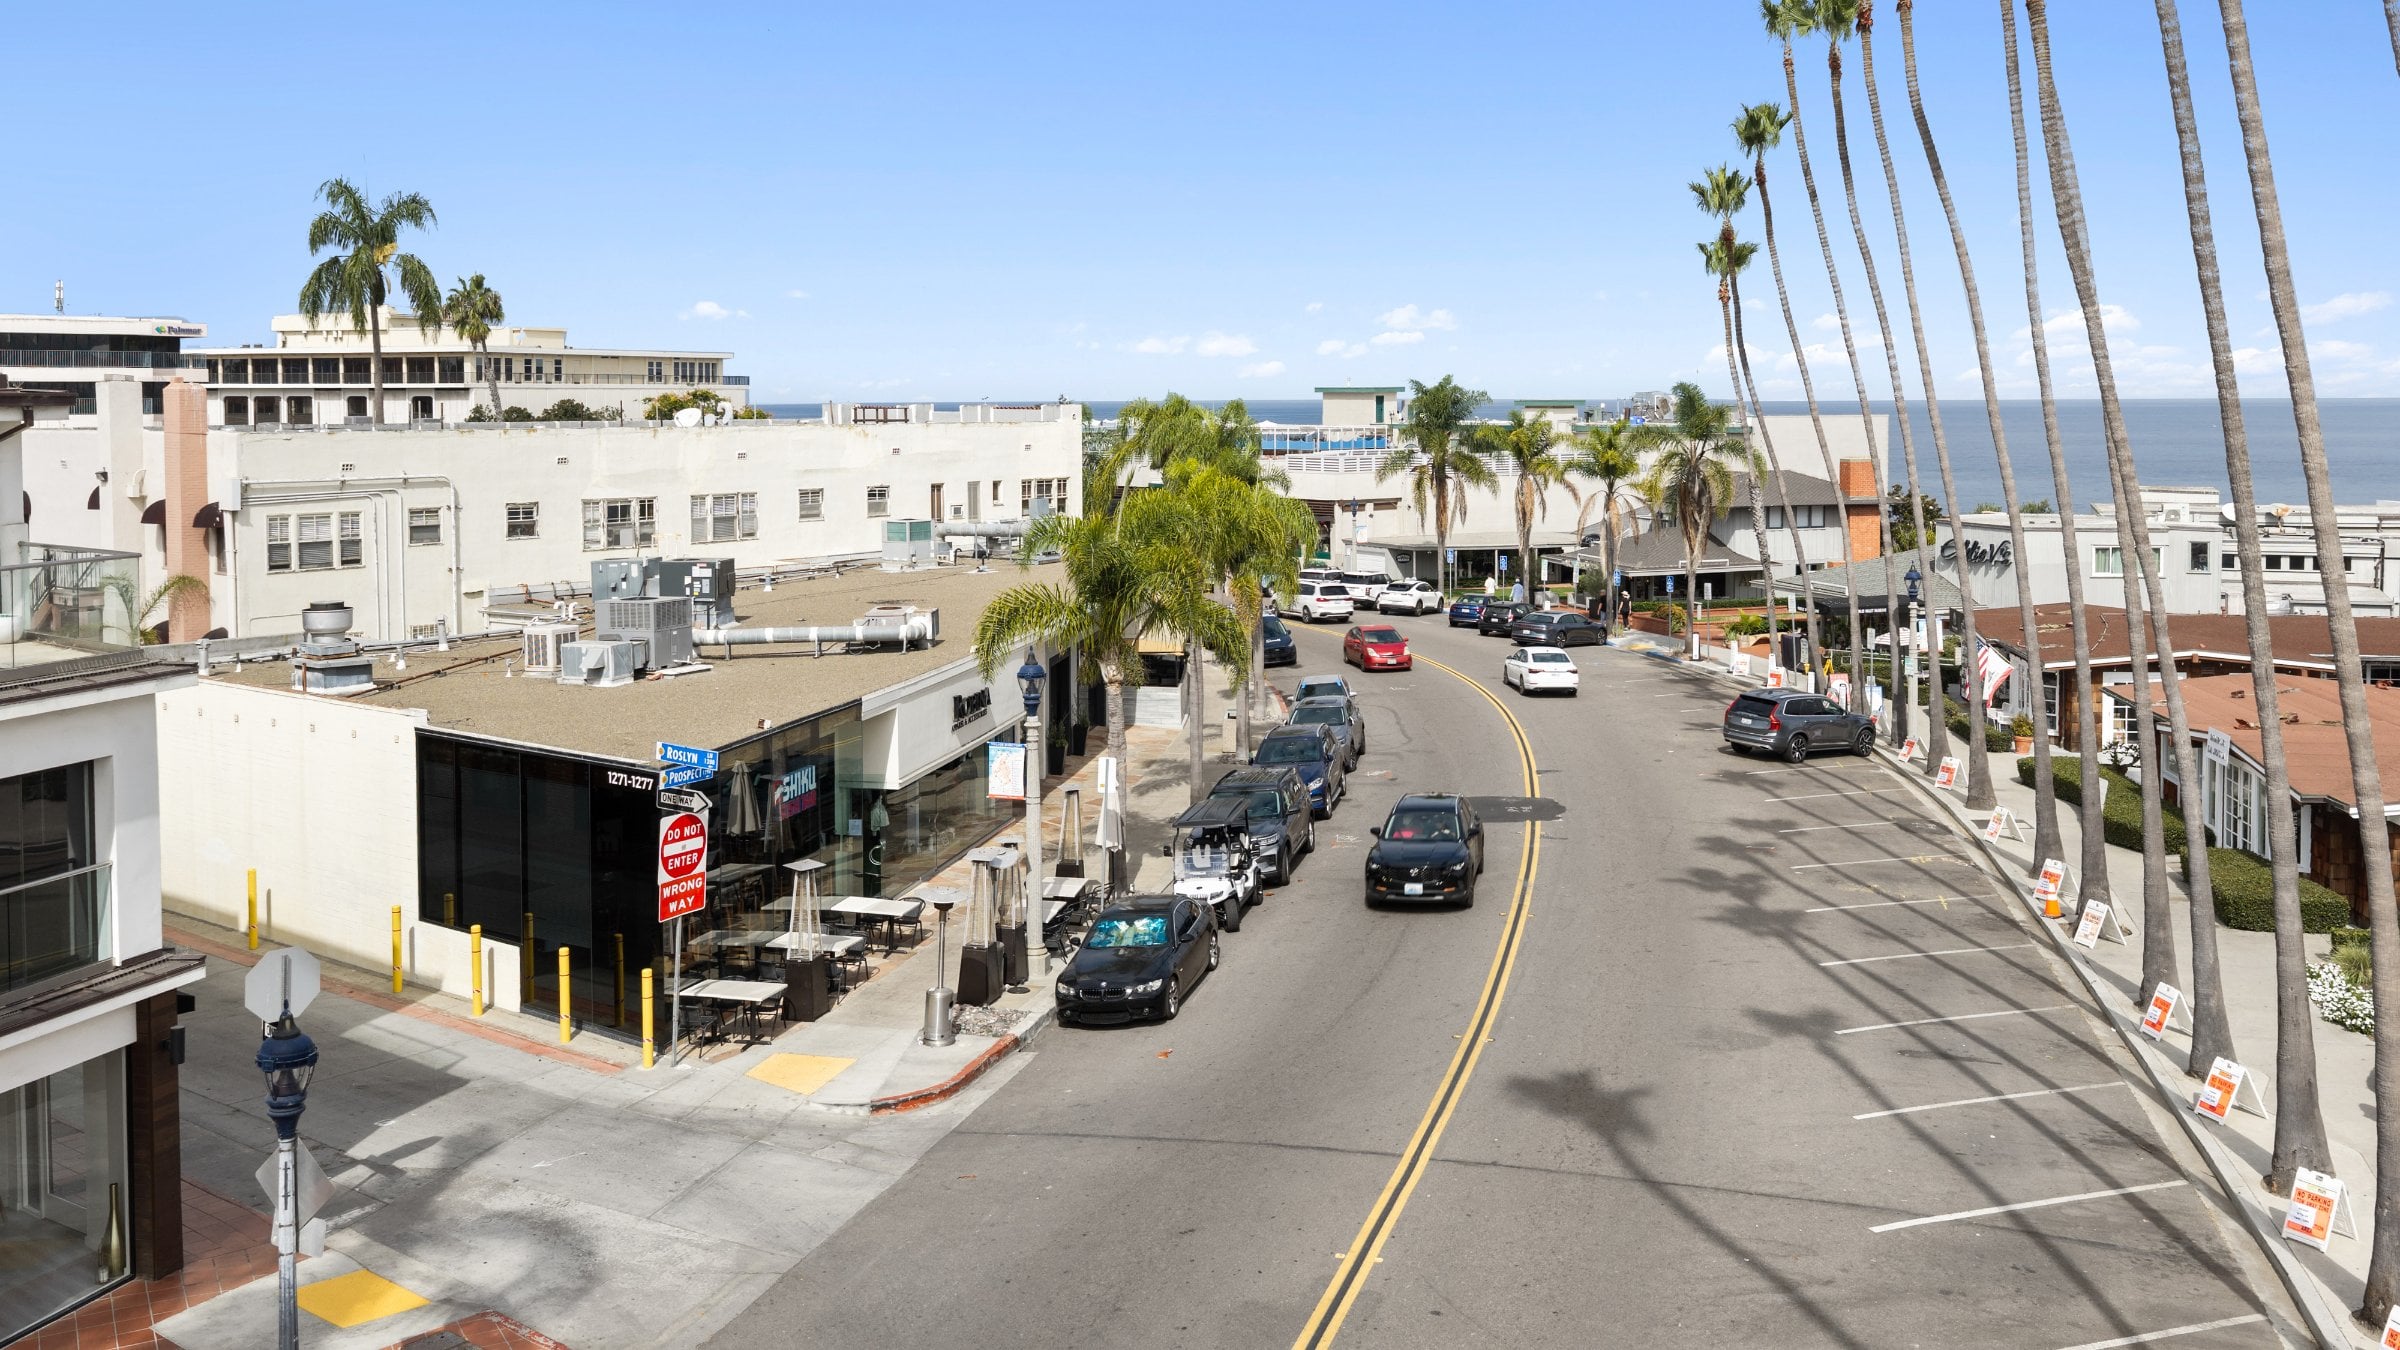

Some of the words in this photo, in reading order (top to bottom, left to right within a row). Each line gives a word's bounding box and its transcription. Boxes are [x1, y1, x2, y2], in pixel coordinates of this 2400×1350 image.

[666, 747, 698, 764] ROSLYN
[607, 771, 654, 791] 1271-1277
[669, 768, 702, 785] PROSPECT
[662, 793, 677, 804] ONE
[679, 796, 694, 807] WAY
[667, 828, 680, 841] DO
[683, 823, 702, 837] NOT
[668, 852, 698, 870] ENTER
[662, 877, 703, 899] WRONG
[669, 895, 695, 913] WAY
[2296, 1190, 2306, 1198] NO
[2307, 1193, 2332, 1207] PARKING
